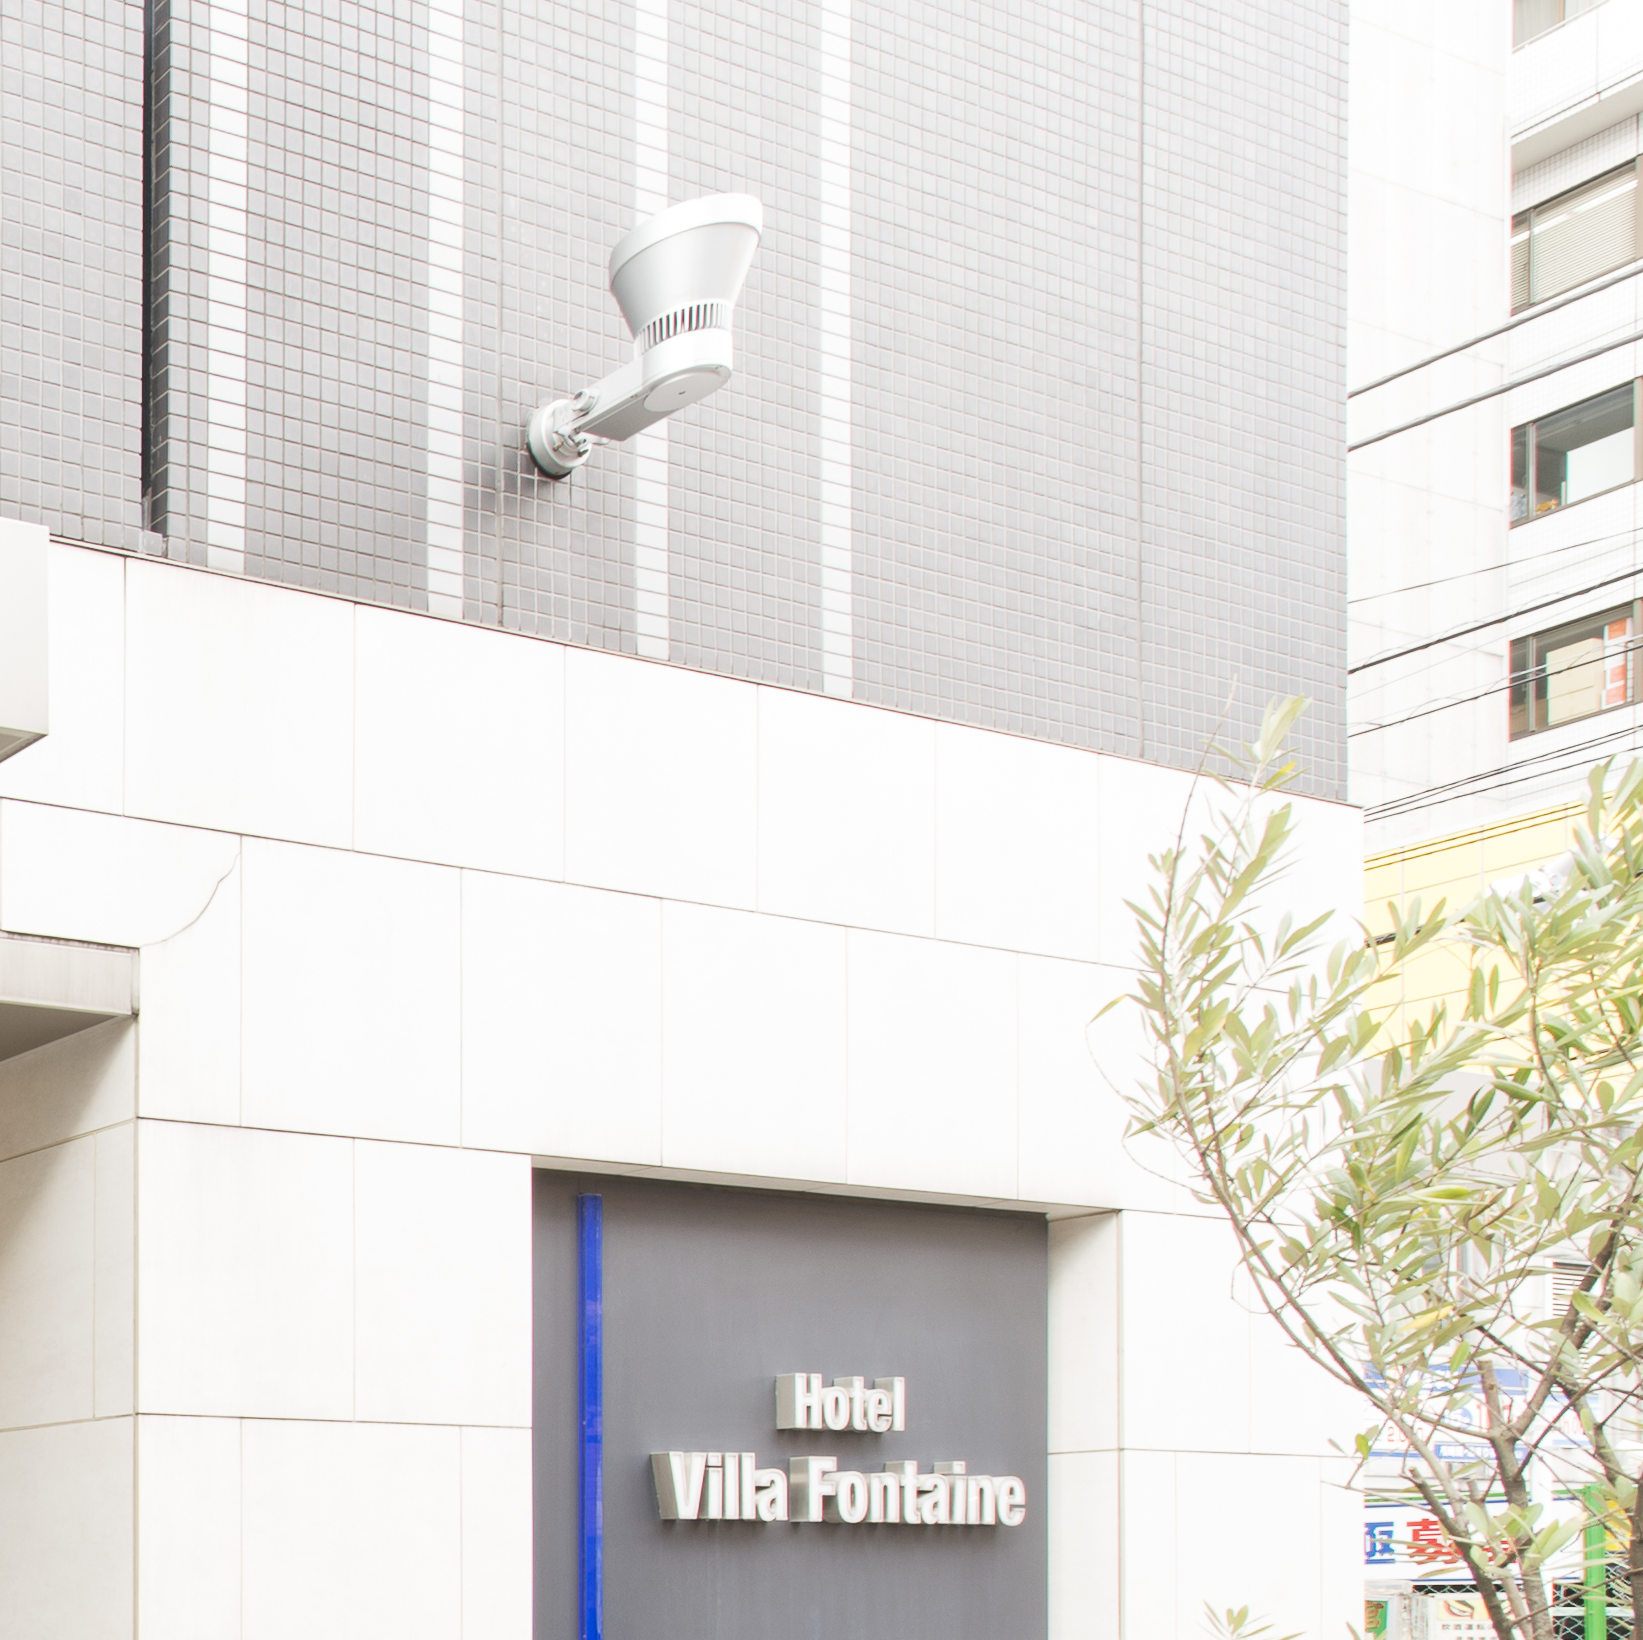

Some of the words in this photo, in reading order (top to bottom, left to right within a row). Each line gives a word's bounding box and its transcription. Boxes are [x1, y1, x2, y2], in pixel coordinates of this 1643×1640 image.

[775, 1372, 906, 1433] Hotel
[650, 1451, 788, 1523] Villa
[789, 1456, 1028, 1528] Fontaine
